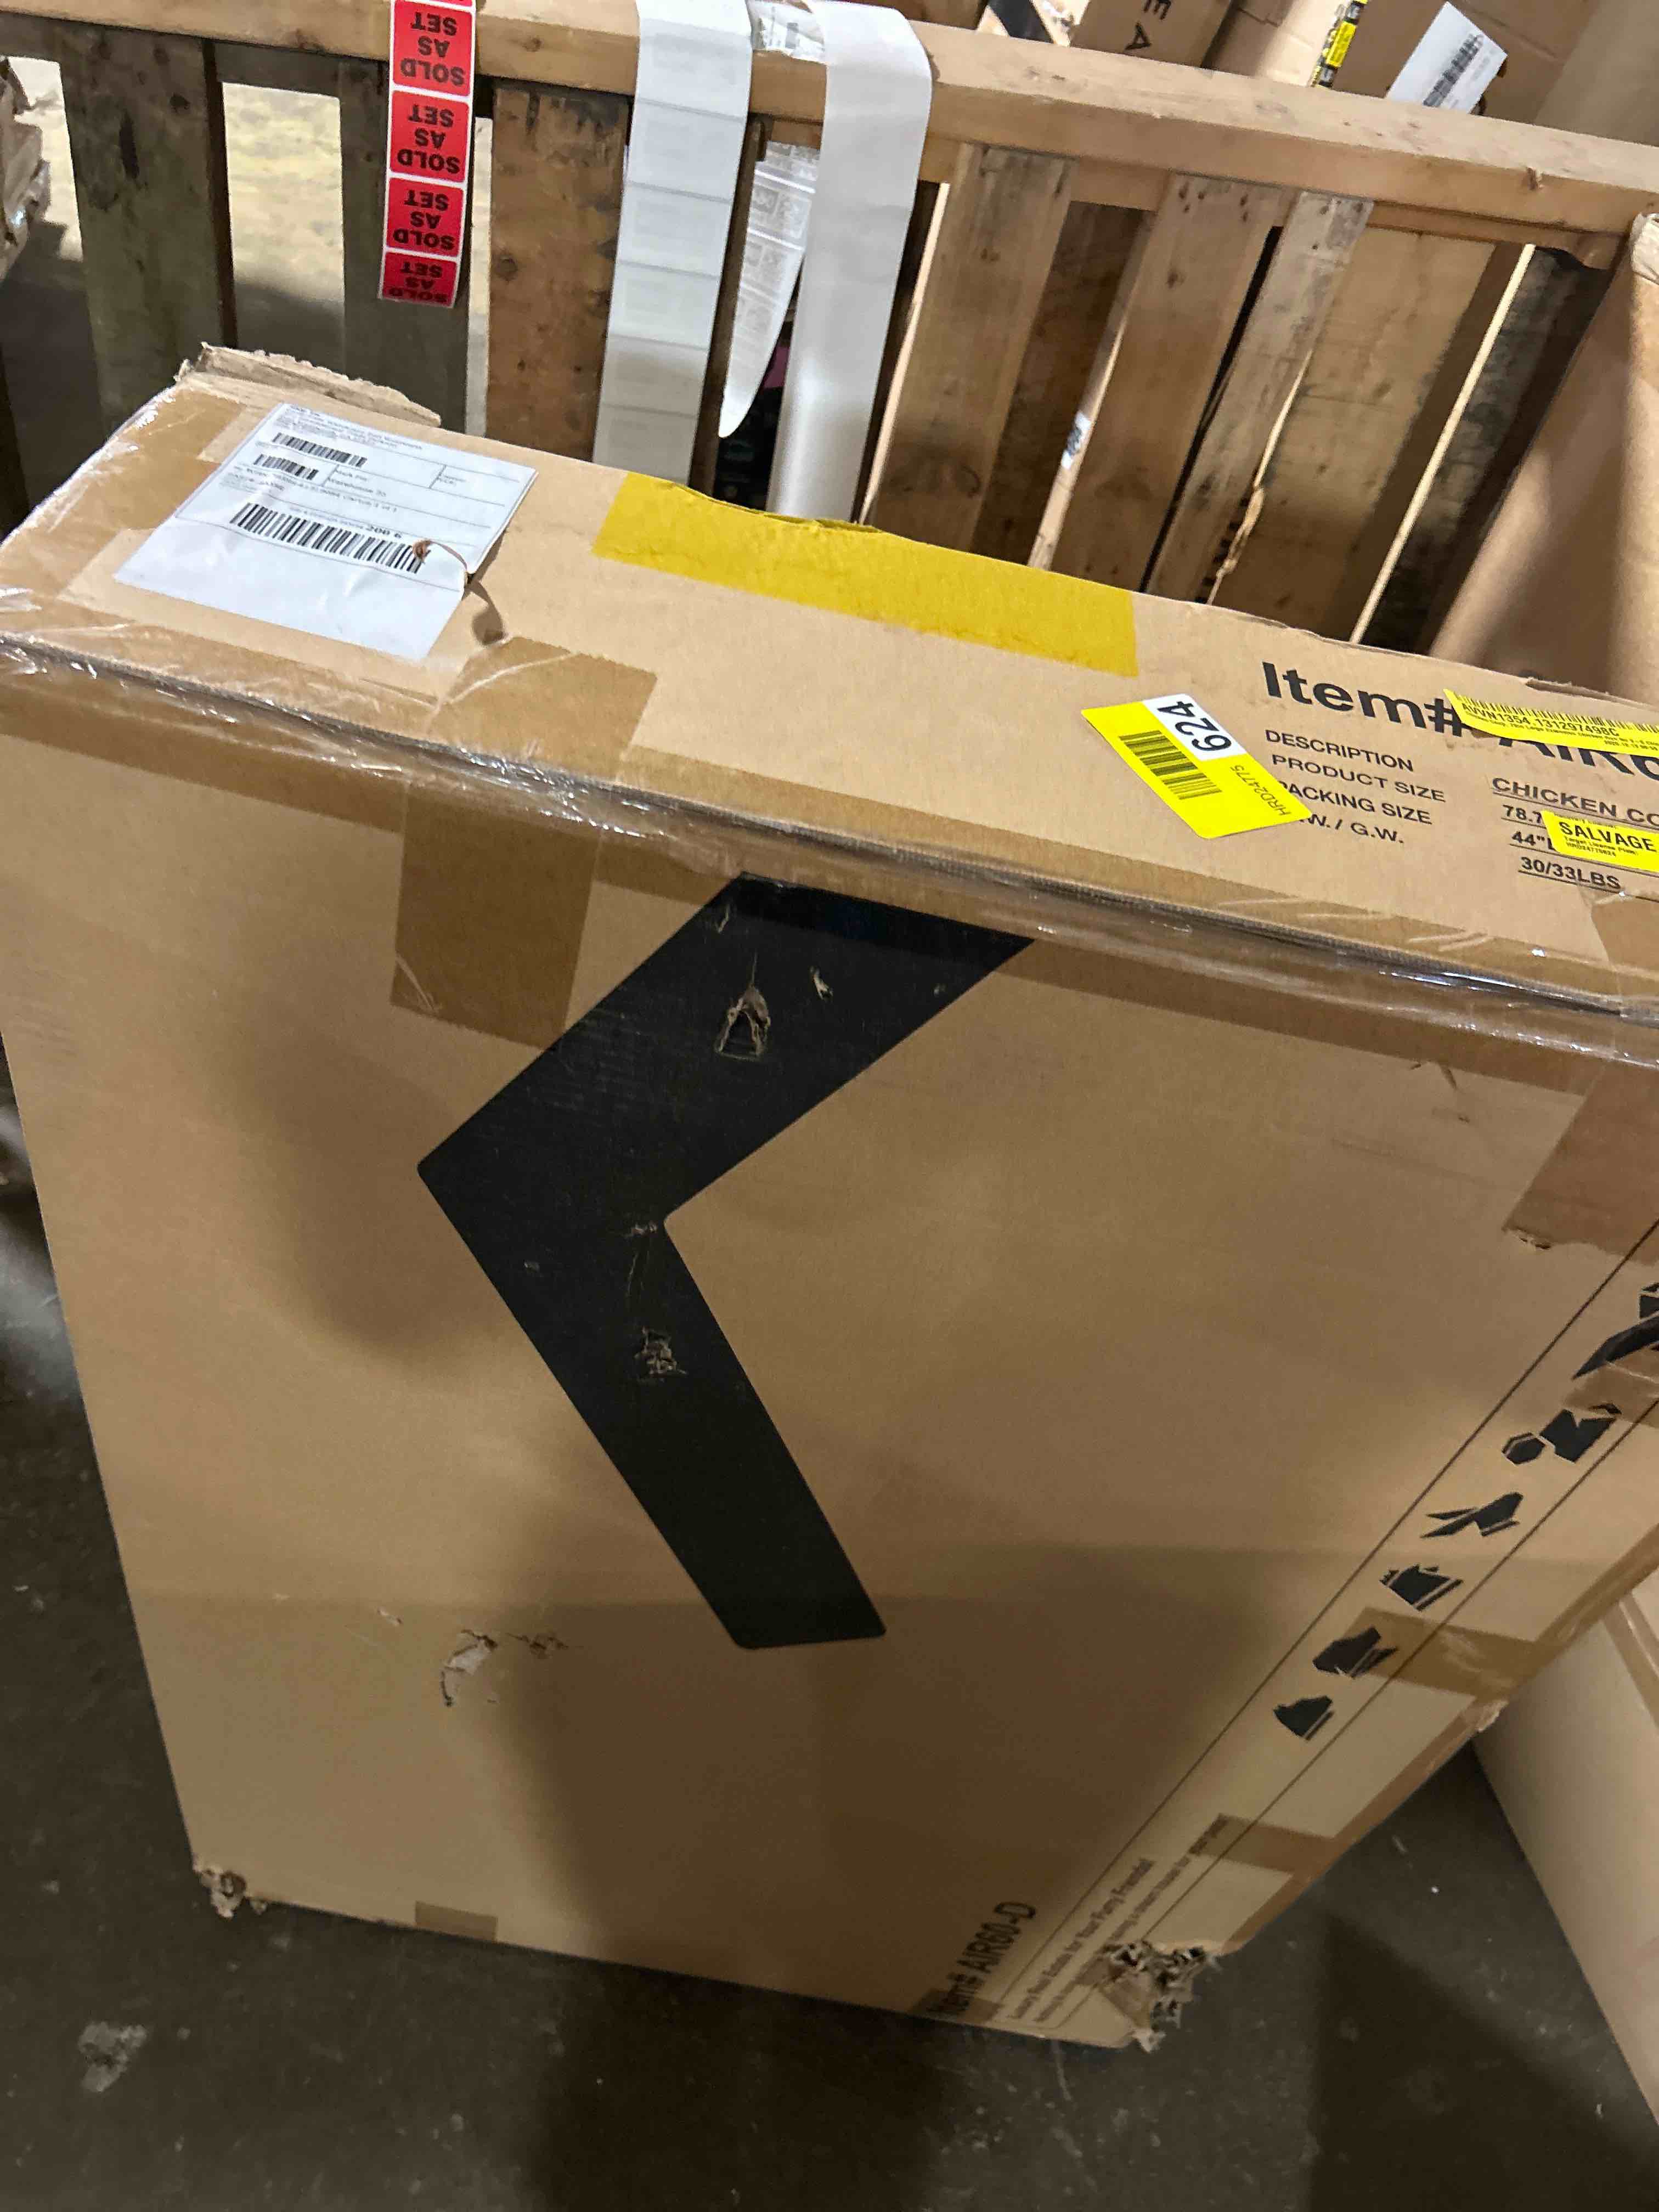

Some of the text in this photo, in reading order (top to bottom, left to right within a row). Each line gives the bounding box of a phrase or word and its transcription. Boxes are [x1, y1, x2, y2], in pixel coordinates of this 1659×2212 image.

[410, 12, 457, 36] SET
[418, 36, 450, 57] AS
[400, 58, 464, 86] SOLD
[408, 104, 454, 127] SET
[415, 127, 445, 149] AS
[397, 149, 460, 173] SOLD
[404, 190, 449, 211] SET
[410, 211, 441, 229] AS
[393, 228, 455, 250] SOLD
[400, 262, 442, 278] SET
[405, 276, 435, 290] AS
[388, 287, 448, 303] SOLD
[1262, 662, 1471, 737] Item#
[1157, 701, 1231, 751] 624
[1265, 729, 1414, 772] DESCRIPTION
[1272, 754, 1446, 803] PRODUCT SIZE
[1230, 765, 1291, 816] HRD24775
[1492, 777, 1616, 817] CHICKEN
[1382, 803, 1432, 825] SIZE
[1351, 823, 1404, 843] G.W.
[1559, 822, 1656, 852] SALVAGE
[1521, 856, 1621, 889] 30/33LBS
